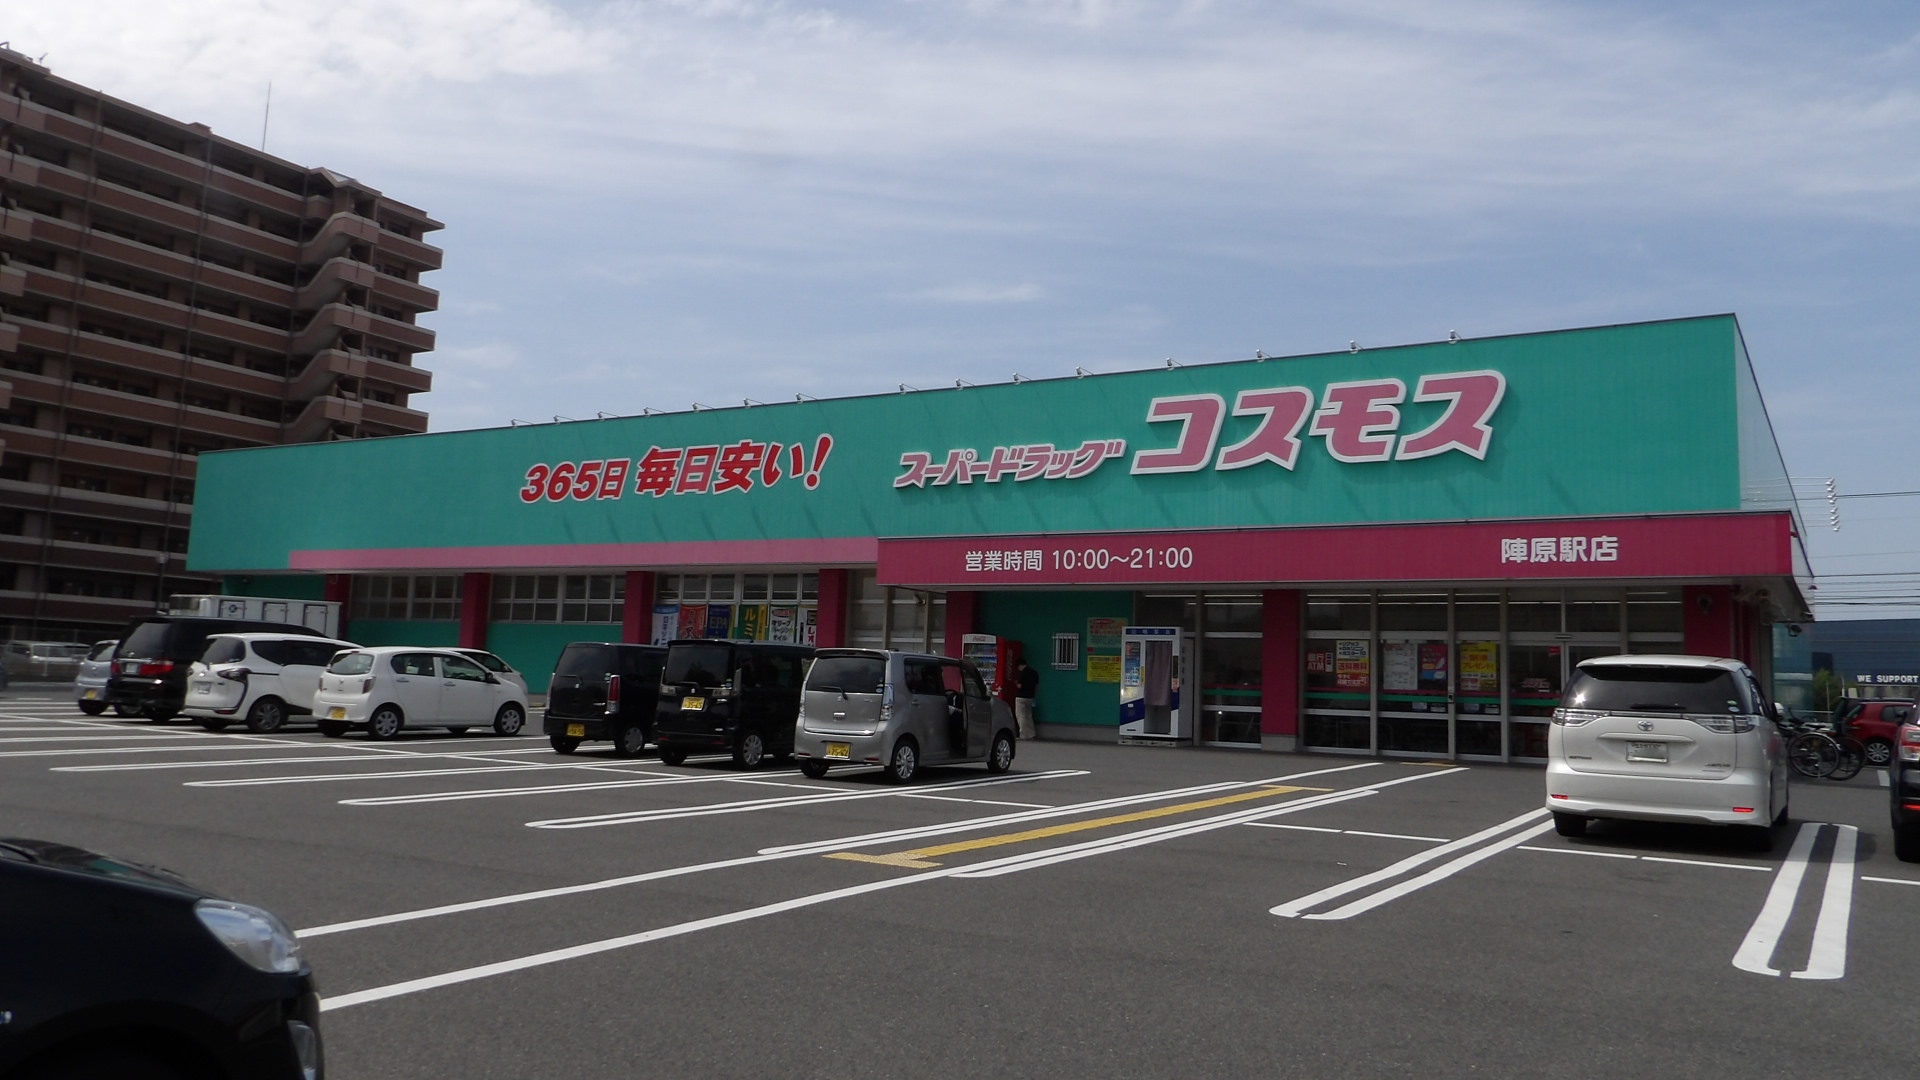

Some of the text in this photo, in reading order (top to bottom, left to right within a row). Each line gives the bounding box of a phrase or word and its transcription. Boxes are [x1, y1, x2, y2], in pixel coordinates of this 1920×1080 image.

[893, 369, 1506, 488] スーパードラッグ コスモス
[520, 433, 834, 502] 365日 毎日安い!
[965, 550, 1043, 572] 営業時間
[1501, 536, 1619, 563] 陣原駅店
[1307, 662, 1325, 672] ATM
[1856, 674, 1919, 684] WE SUPPORT
